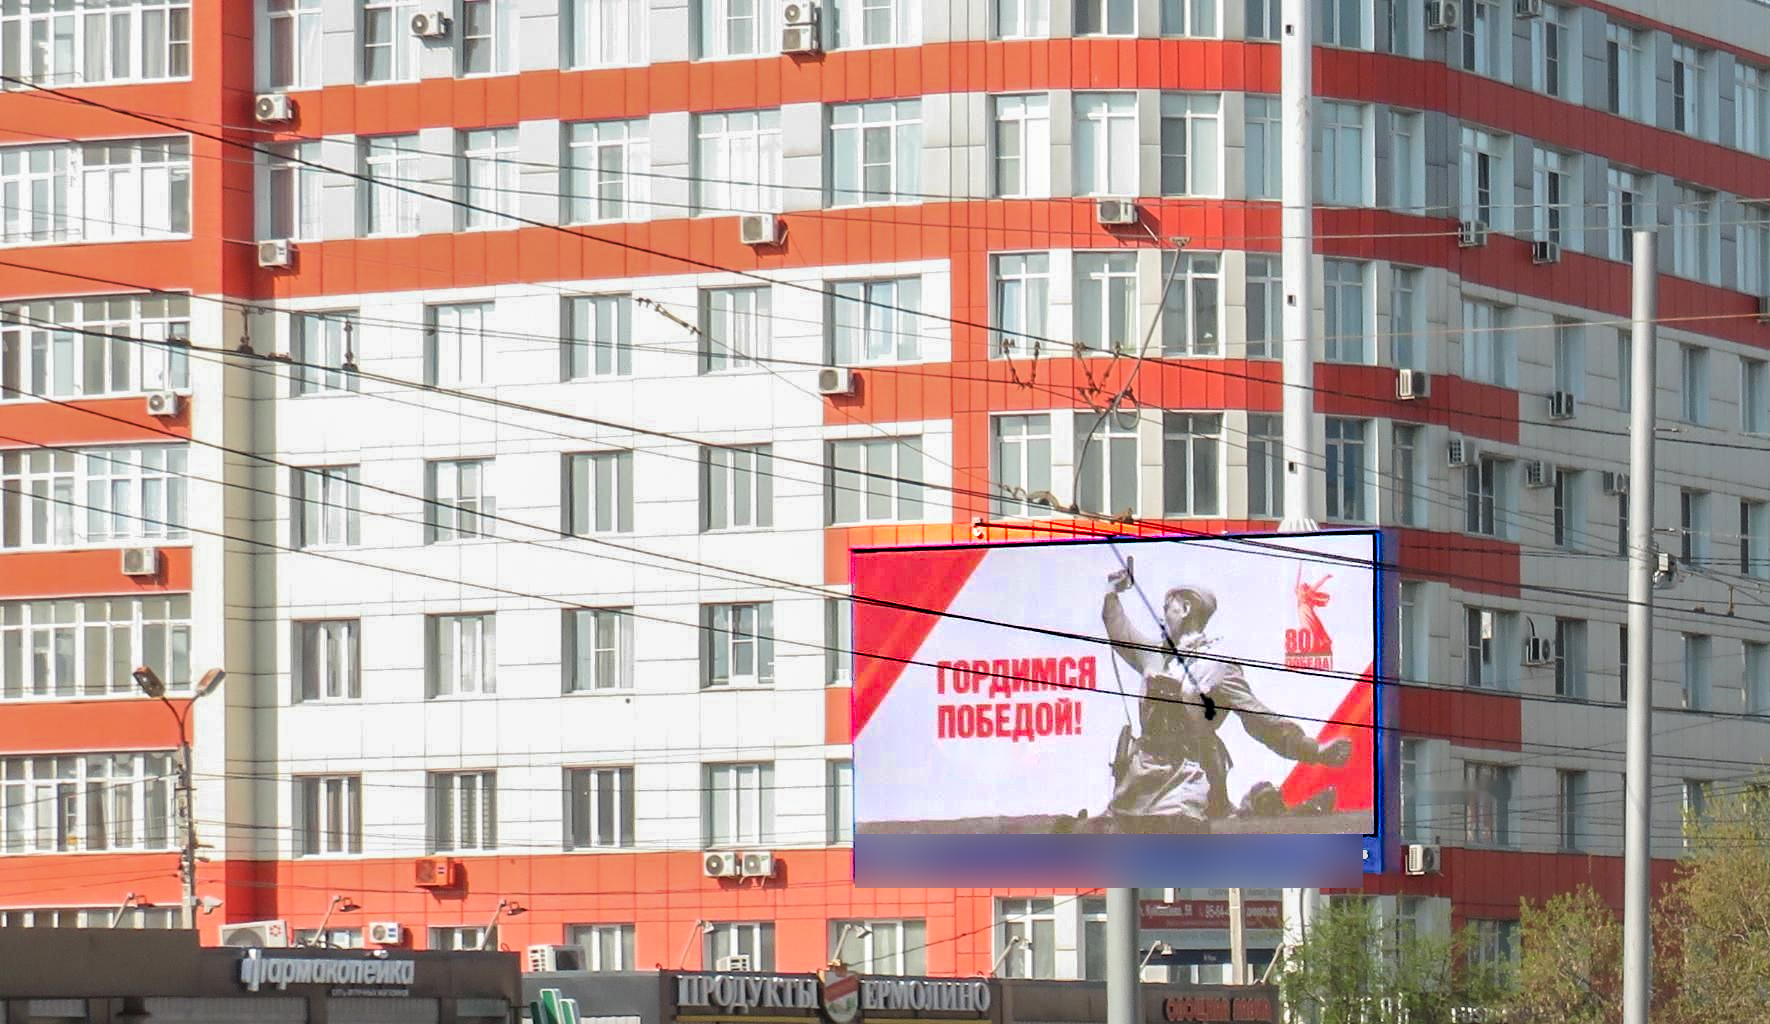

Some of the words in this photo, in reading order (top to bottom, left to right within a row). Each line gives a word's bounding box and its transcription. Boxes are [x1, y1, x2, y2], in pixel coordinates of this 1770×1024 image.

[937, 656, 1097, 698] ГОРДИМСЯ
[937, 697, 1082, 742] ПОБЕДОЙ!
[677, 975, 821, 1014] ПРОДУКТЫ
[861, 980, 991, 1011] ЕРМОЛИНО
